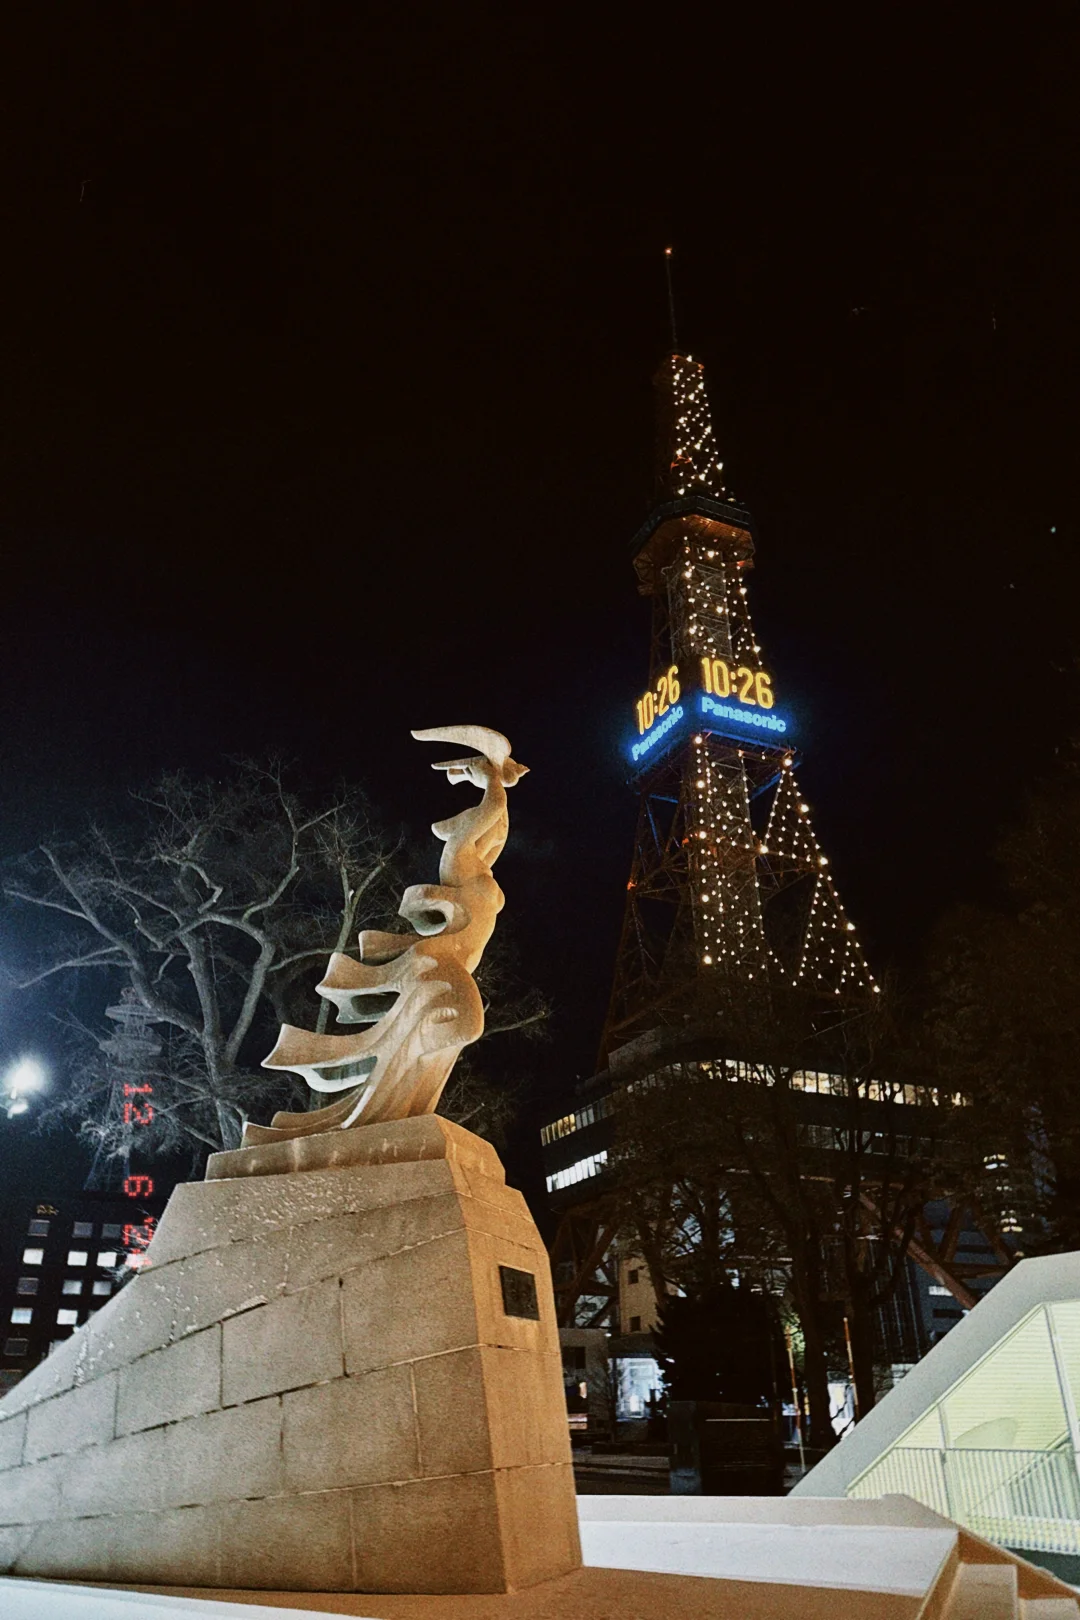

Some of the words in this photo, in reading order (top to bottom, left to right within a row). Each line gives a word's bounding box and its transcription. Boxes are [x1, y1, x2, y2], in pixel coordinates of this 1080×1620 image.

[636, 665, 681, 735] 10:26
[701, 657, 774, 709] 10:26
[631, 705, 684, 761] Panasonic
[701, 696, 787, 733] Panasonic
